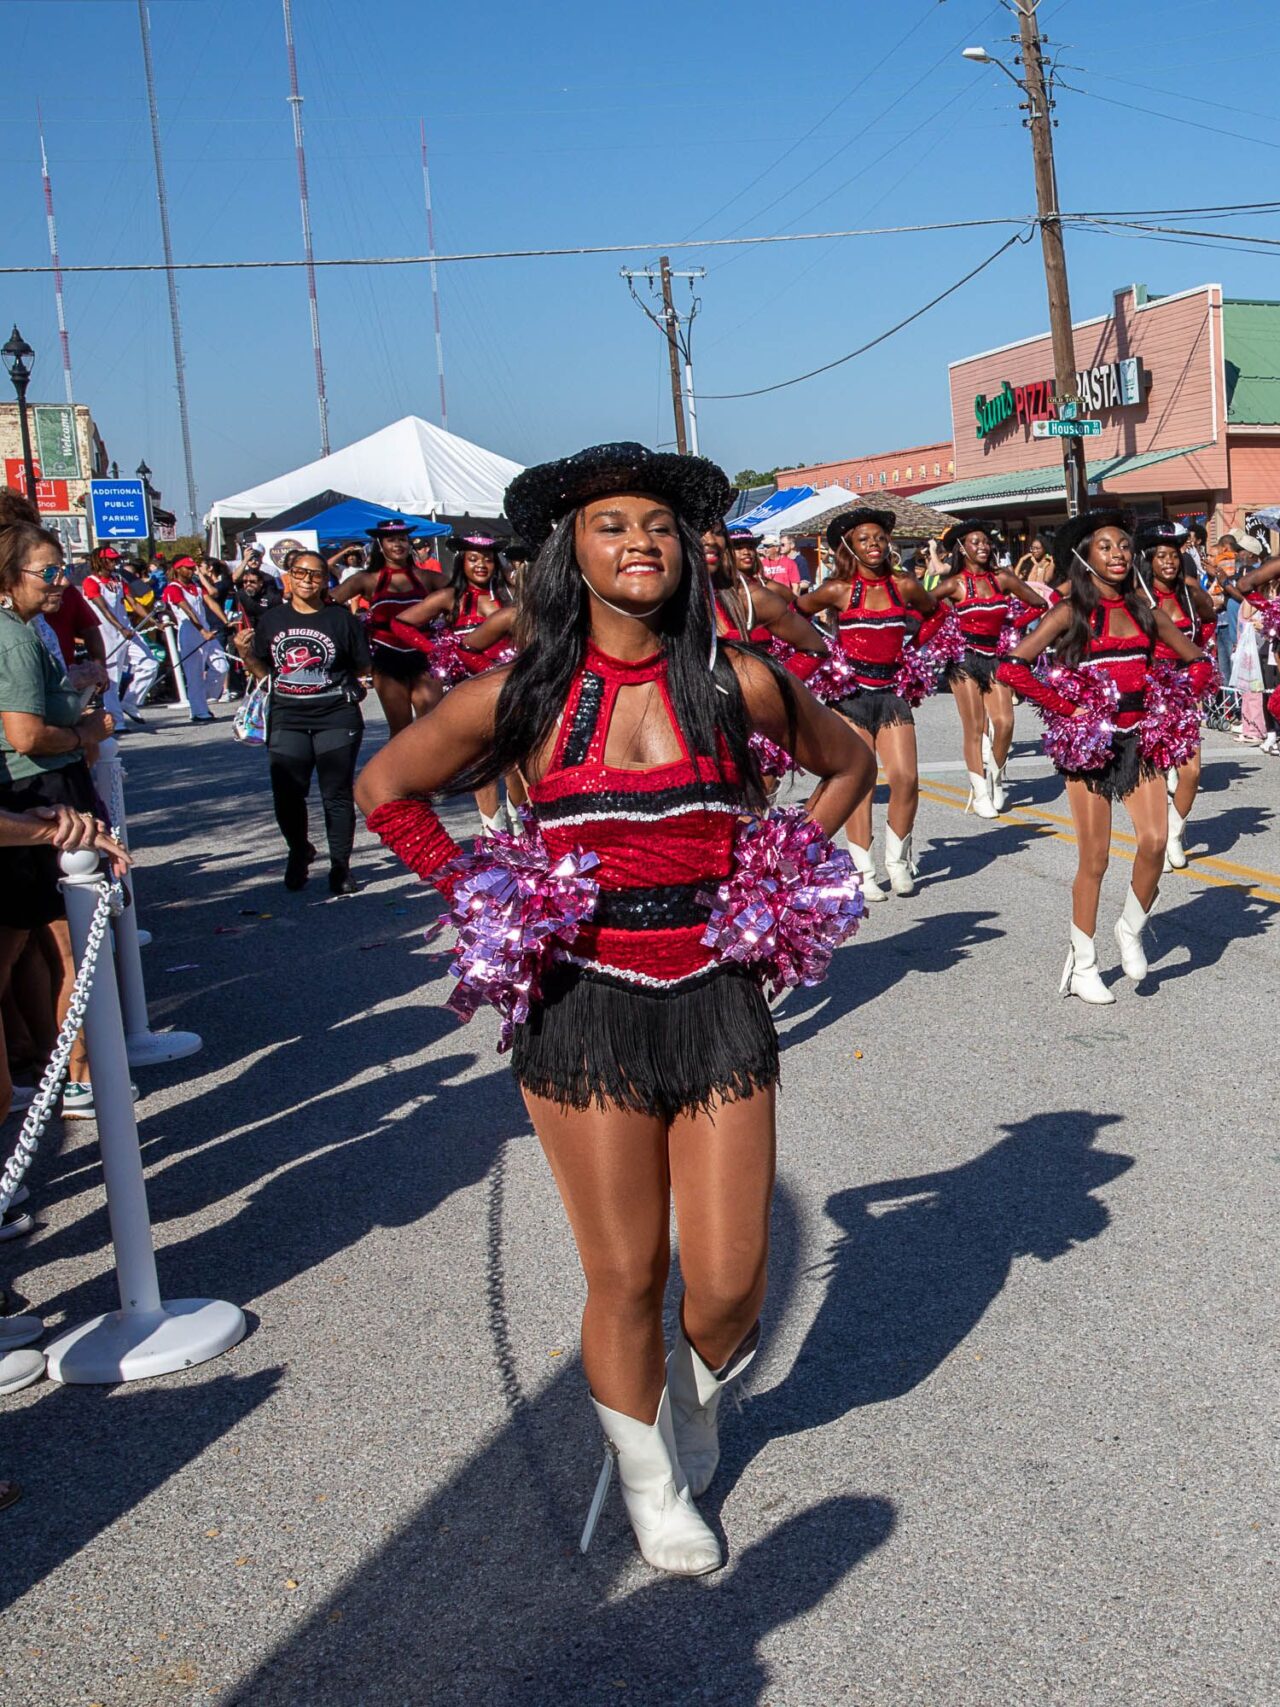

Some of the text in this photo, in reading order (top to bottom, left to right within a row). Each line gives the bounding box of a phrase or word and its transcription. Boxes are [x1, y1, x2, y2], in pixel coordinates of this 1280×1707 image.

[975, 381, 1012, 439] Sam's
[1015, 380, 1056, 426] PIZZA
[60, 411, 73, 457] Welcome
[1051, 422, 1090, 435] Houston
[102, 514, 140, 522] PARKING
